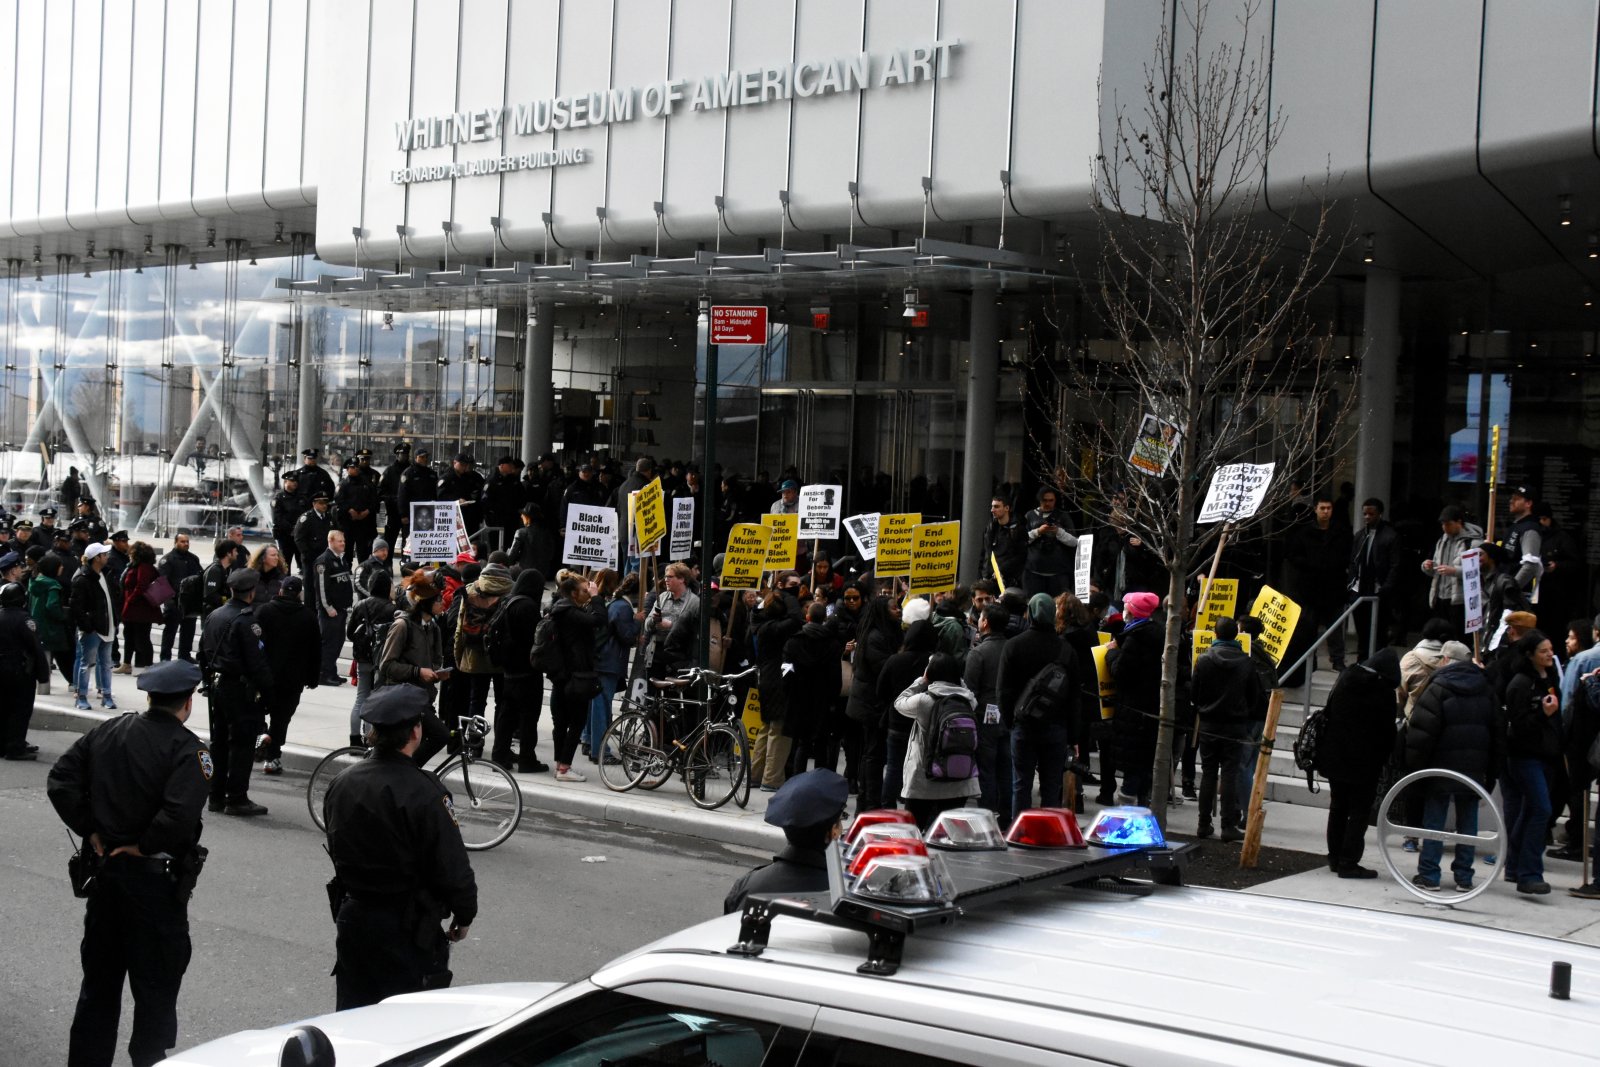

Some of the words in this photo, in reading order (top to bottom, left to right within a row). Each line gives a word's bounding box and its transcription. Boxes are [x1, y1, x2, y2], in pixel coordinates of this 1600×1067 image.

[395, 105, 505, 151] WHITNEY
[510, 87, 634, 135] MUSEUM
[641, 78, 686, 118] OF
[690, 51, 872, 112] AMERICAN
[879, 38, 961, 87] ART
[389, 164, 445, 184] LEONARD
[464, 154, 515, 175] LAUDER
[519, 148, 585, 169] BUILDING
[714, 309, 724, 317] NO
[725, 309, 758, 317] STANDING
[730, 318, 752, 326] Midnight
[722, 325, 734, 333] Days
[1218, 465, 1258, 475] Black
[1262, 467, 1271, 475] &
[1217, 473, 1262, 483] Brown
[1215, 491, 1253, 502] Lives
[1206, 501, 1256, 512] Matter
[578, 512, 603, 523] Black
[571, 521, 610, 534] Disabled
[772, 519, 786, 527] End
[742, 527, 756, 536] The
[884, 527, 913, 535] Broken
[925, 528, 943, 537] End
[578, 535, 602, 546] Lives
[733, 536, 762, 545] Muslim
[919, 539, 952, 548] Broken
[573, 545, 604, 557] Matter
[728, 545, 745, 554] Ban
[747, 546, 752, 554] is
[913, 549, 954, 559] Windows
[728, 557, 758, 566] African
[915, 560, 954, 571] Policing!
[734, 567, 749, 575] Ban
[1209, 603, 1218, 611] War
[1270, 596, 1287, 611] End
[1262, 602, 1287, 624] Police
[1258, 611, 1287, 634] Murder
[1200, 635, 1213, 644] End
[1264, 628, 1283, 646] lack
